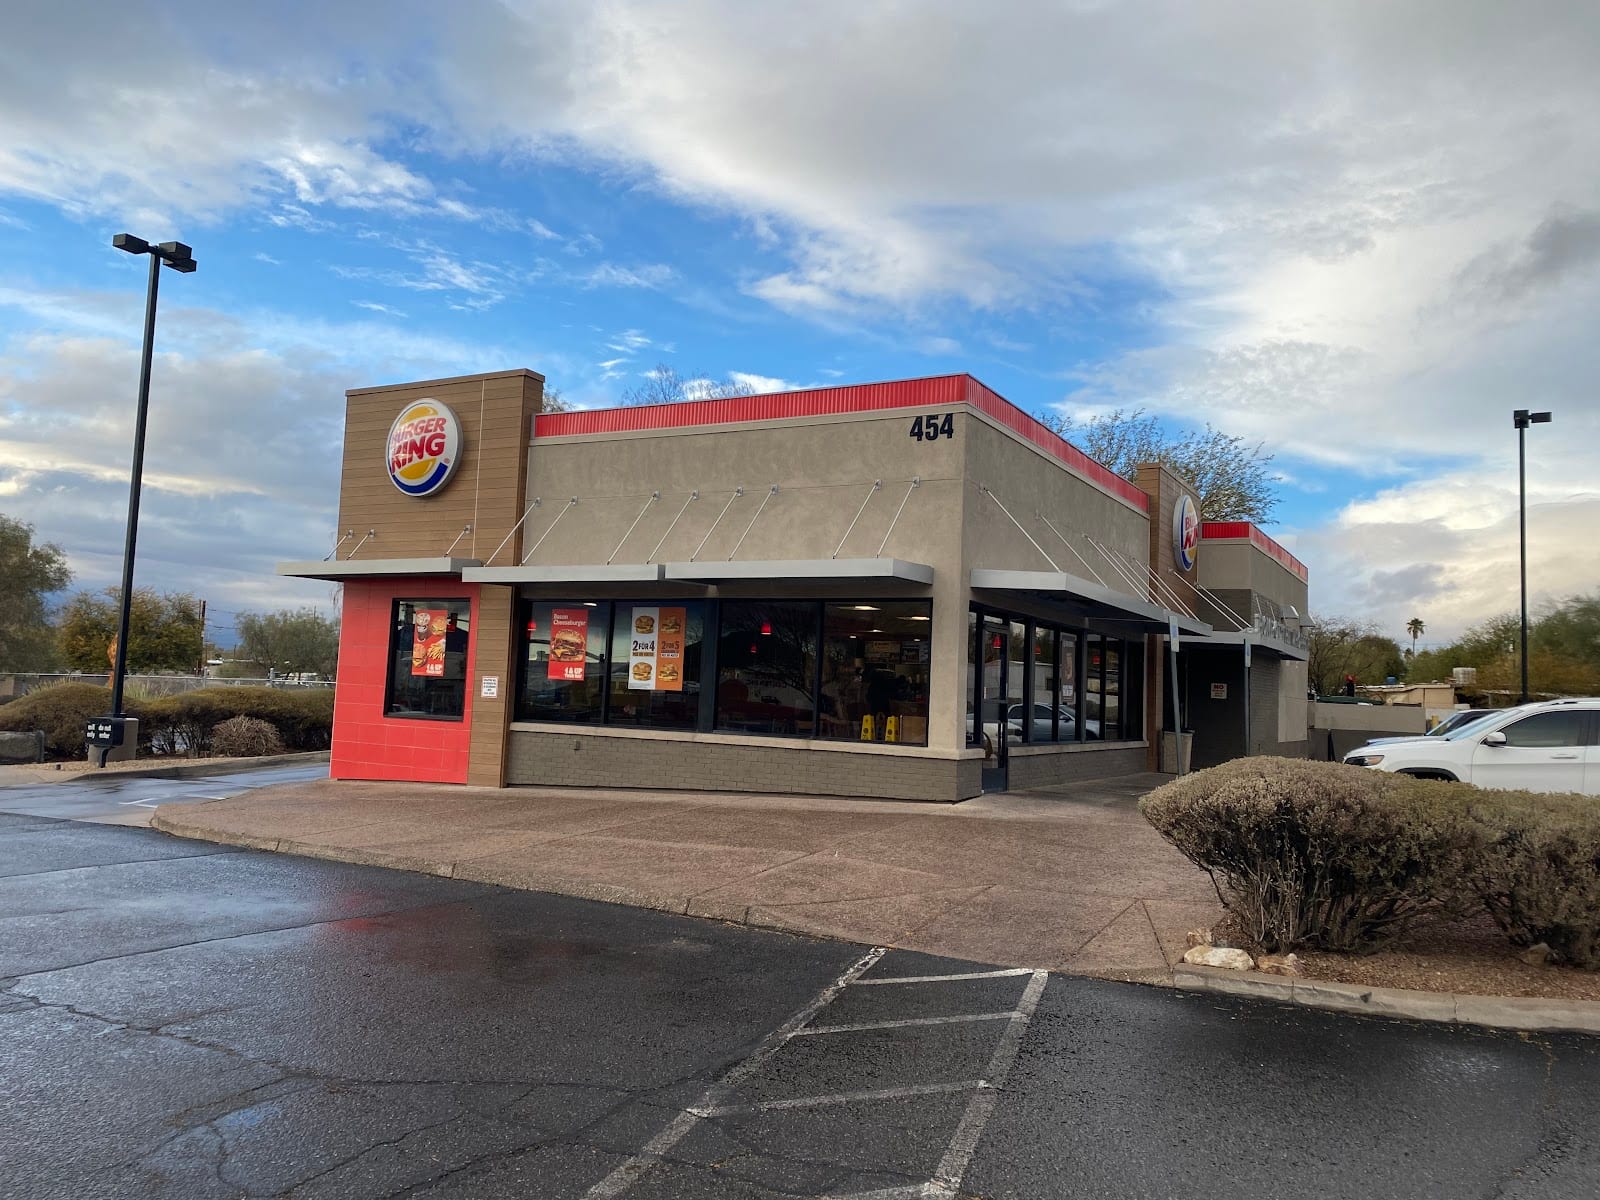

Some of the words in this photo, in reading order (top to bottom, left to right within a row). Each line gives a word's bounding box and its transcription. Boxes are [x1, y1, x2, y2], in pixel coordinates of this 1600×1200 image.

[910, 413, 953, 441] 454
[391, 432, 446, 474] KING
[632, 640, 639, 651] 2
[638, 642, 649, 650] FOR
[661, 641, 666, 650] 2
